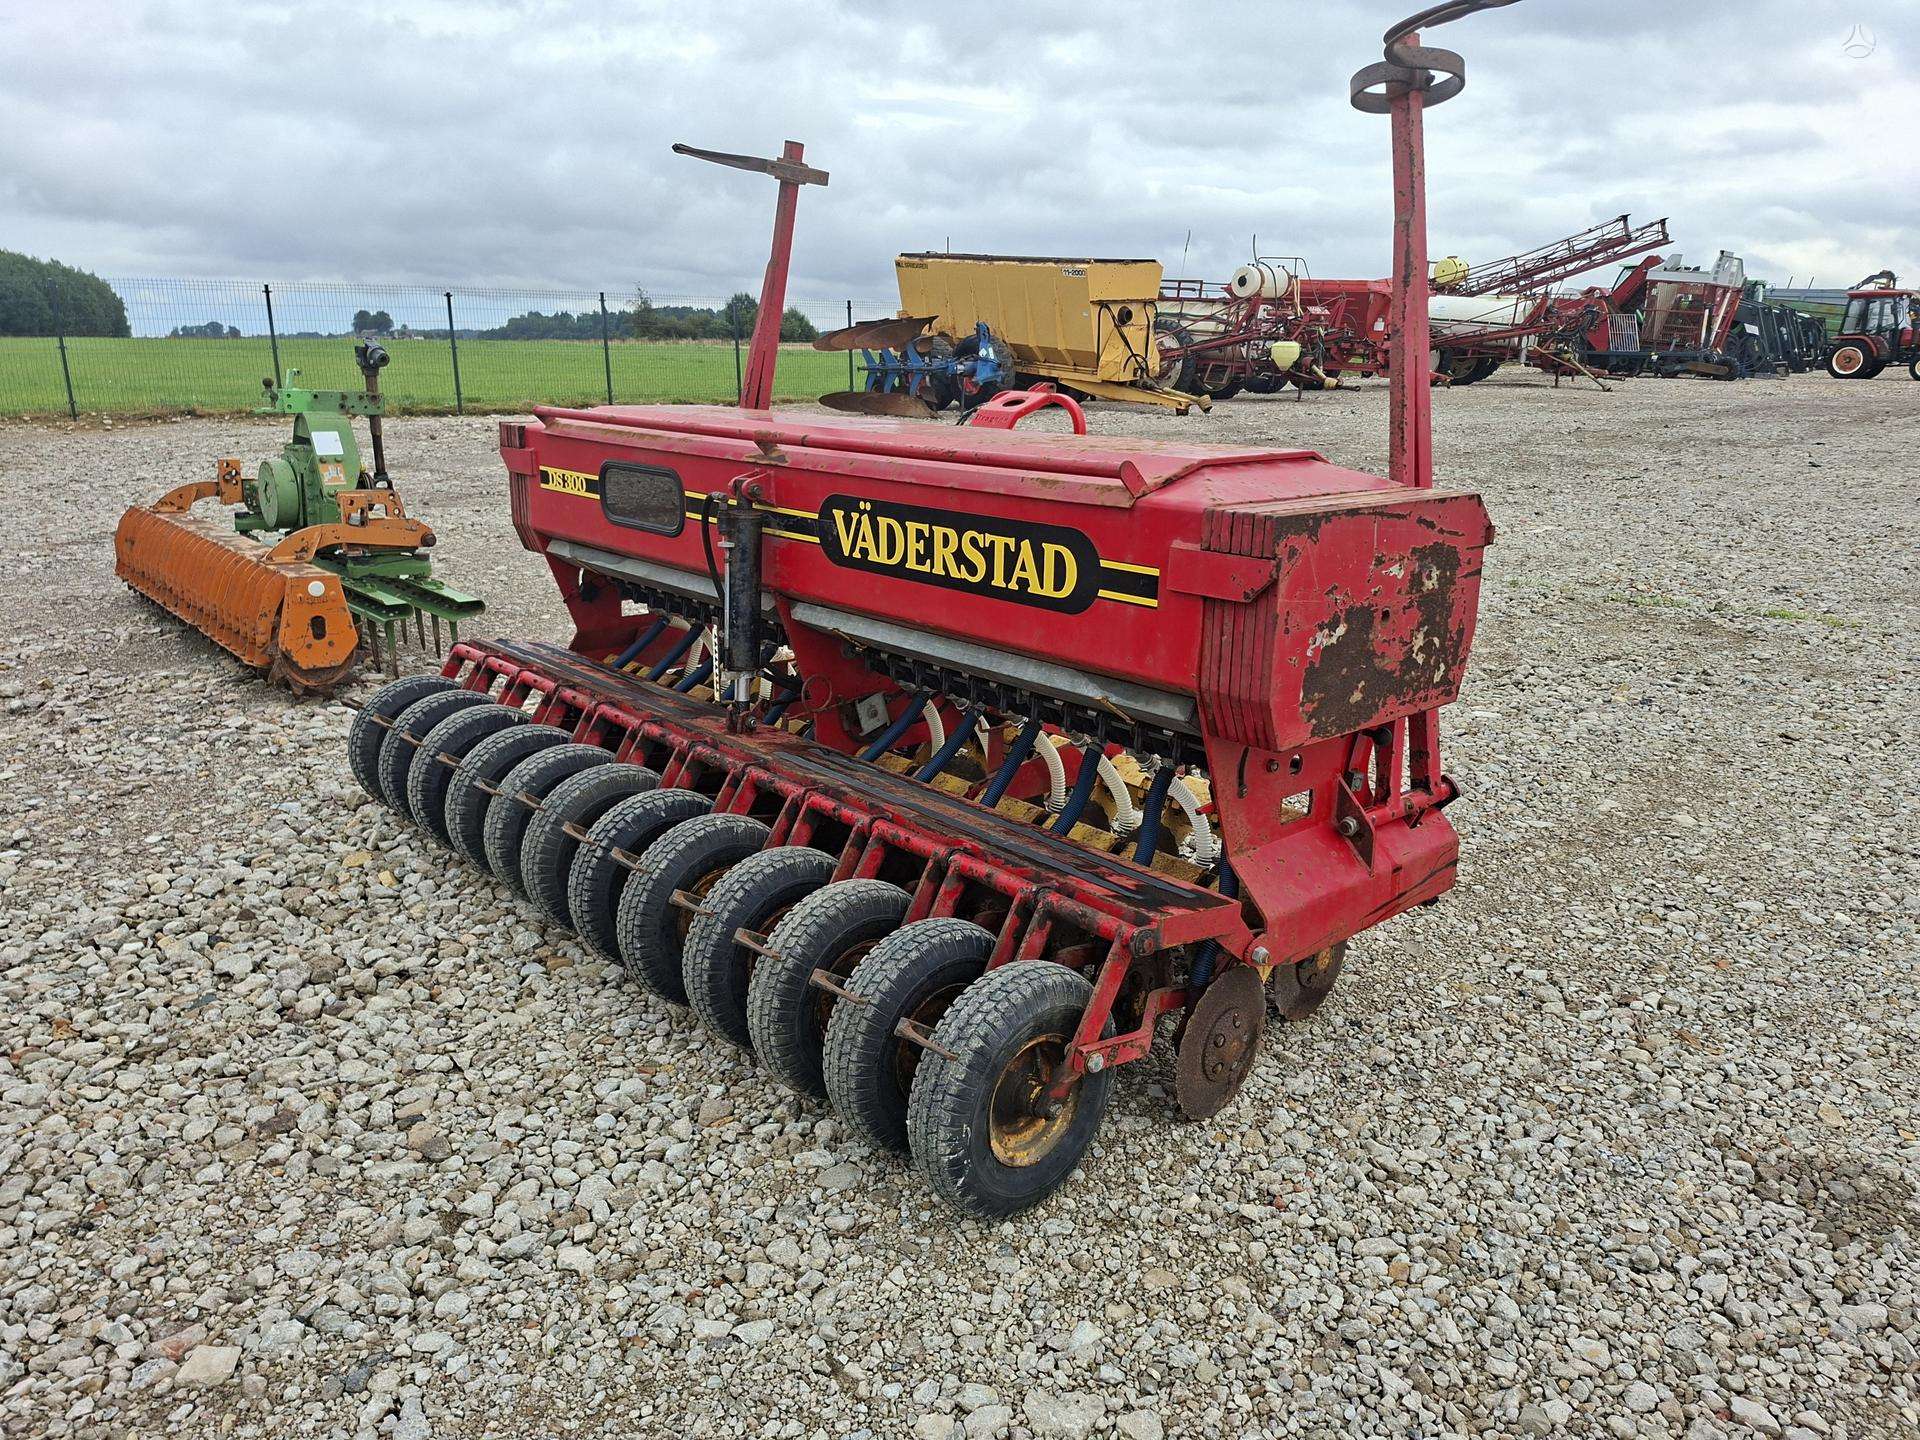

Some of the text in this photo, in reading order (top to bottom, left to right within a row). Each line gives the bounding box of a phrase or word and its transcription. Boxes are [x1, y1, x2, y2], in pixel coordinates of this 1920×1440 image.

[548, 469, 587, 492] DS 300
[832, 501, 1078, 599] VÄDERSTAD
